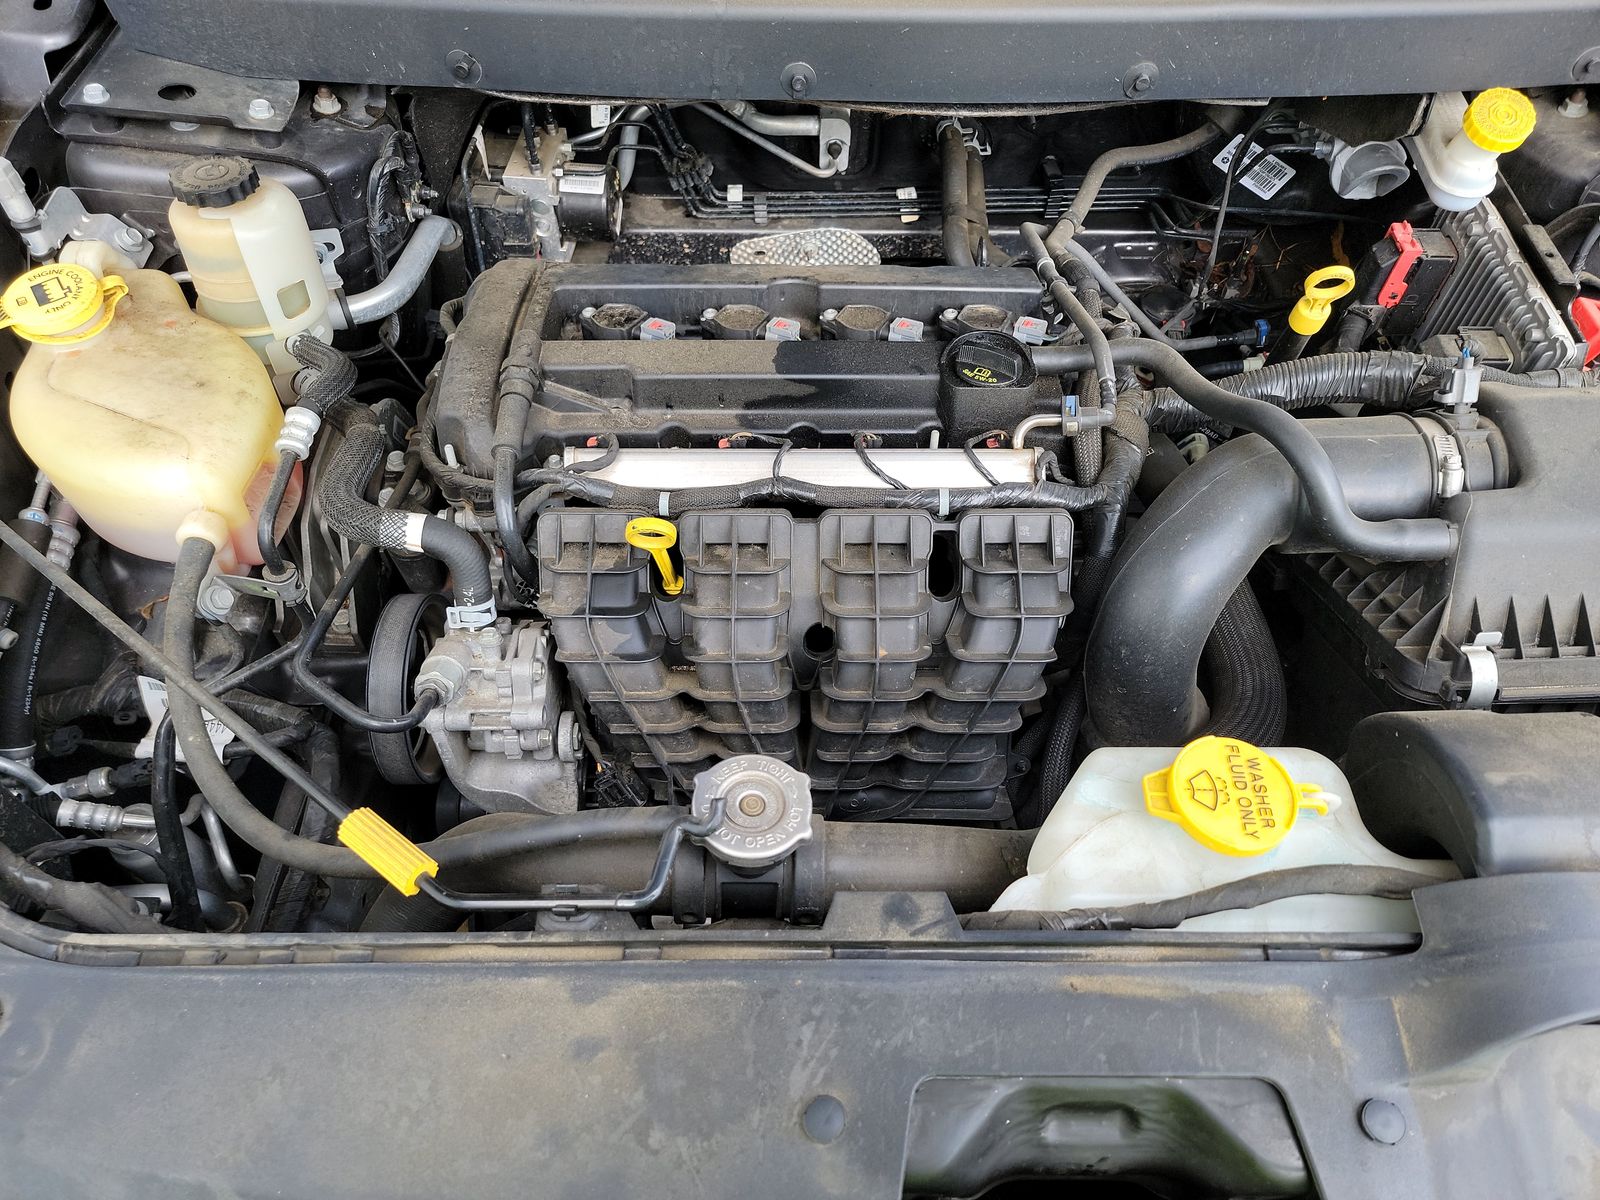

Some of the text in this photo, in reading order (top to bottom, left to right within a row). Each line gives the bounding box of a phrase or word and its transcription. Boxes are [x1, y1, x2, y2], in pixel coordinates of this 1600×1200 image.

[27, 268, 84, 314] ENGINE COOLANT ONLY
[962, 368, 975, 378] SAE
[711, 760, 748, 784] KEEP
[1223, 744, 1261, 840] FLUID ONLY
[1247, 756, 1276, 829] WASHER
[744, 833, 786, 848] OPEN
[784, 806, 803, 832] HOT
